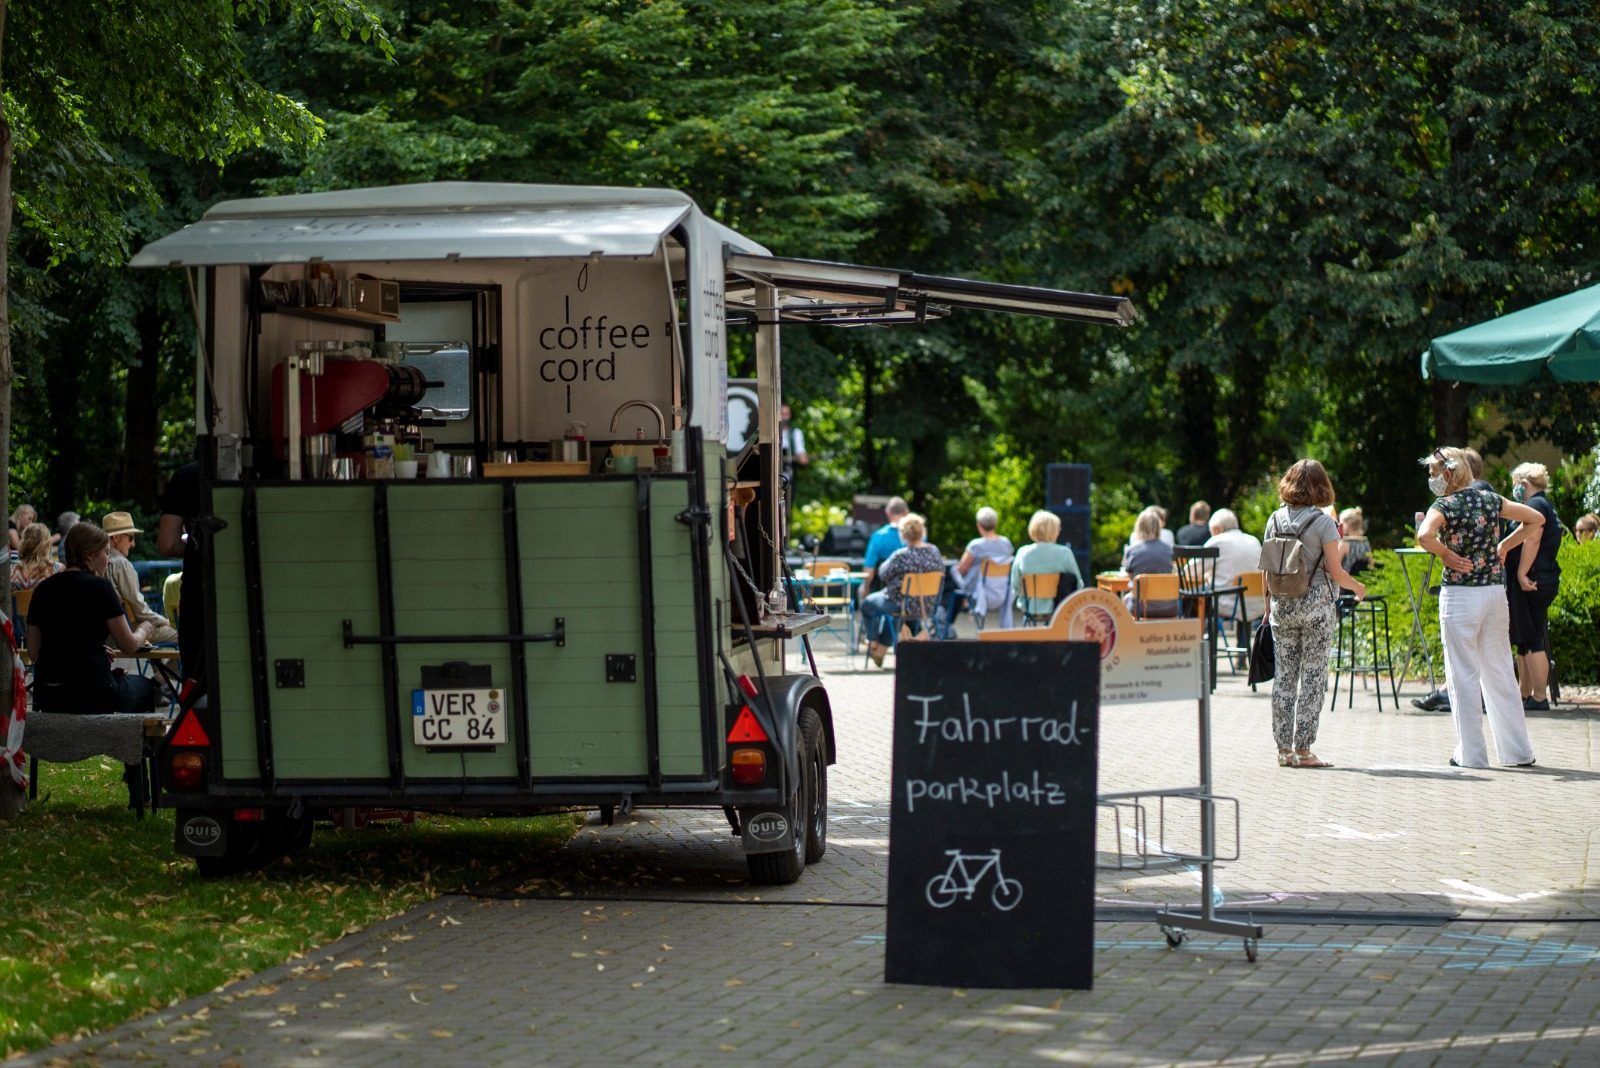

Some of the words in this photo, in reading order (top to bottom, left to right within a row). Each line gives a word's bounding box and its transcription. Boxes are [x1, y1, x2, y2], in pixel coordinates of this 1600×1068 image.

[539, 316, 651, 350] coffee
[539, 351, 616, 382] cord
[431, 693, 476, 716] VER
[422, 718, 452, 740] CC
[467, 718, 495, 740] 84
[906, 692, 1091, 745] Fahrrad-
[906, 770, 1067, 813] parkplatz
[186, 825, 218, 837] DUIS
[751, 820, 786, 833] DUIS
